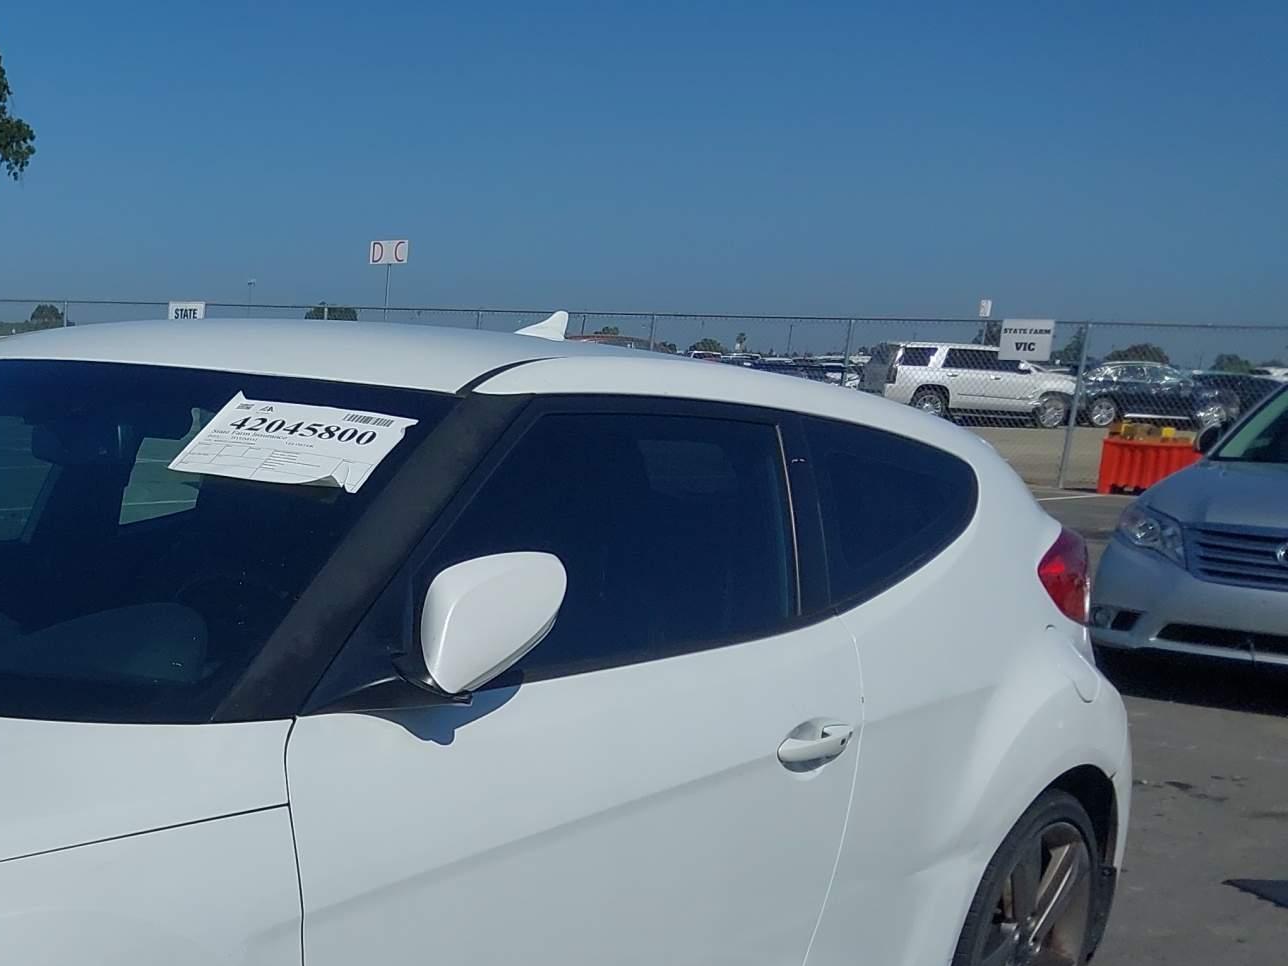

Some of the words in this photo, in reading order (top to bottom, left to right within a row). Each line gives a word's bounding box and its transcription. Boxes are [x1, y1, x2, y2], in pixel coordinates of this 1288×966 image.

[372, 241, 383, 263] D
[394, 241, 405, 262] C
[174, 308, 198, 319] STATE
[1015, 342, 1036, 351] VIC
[230, 416, 377, 446] 42045800
